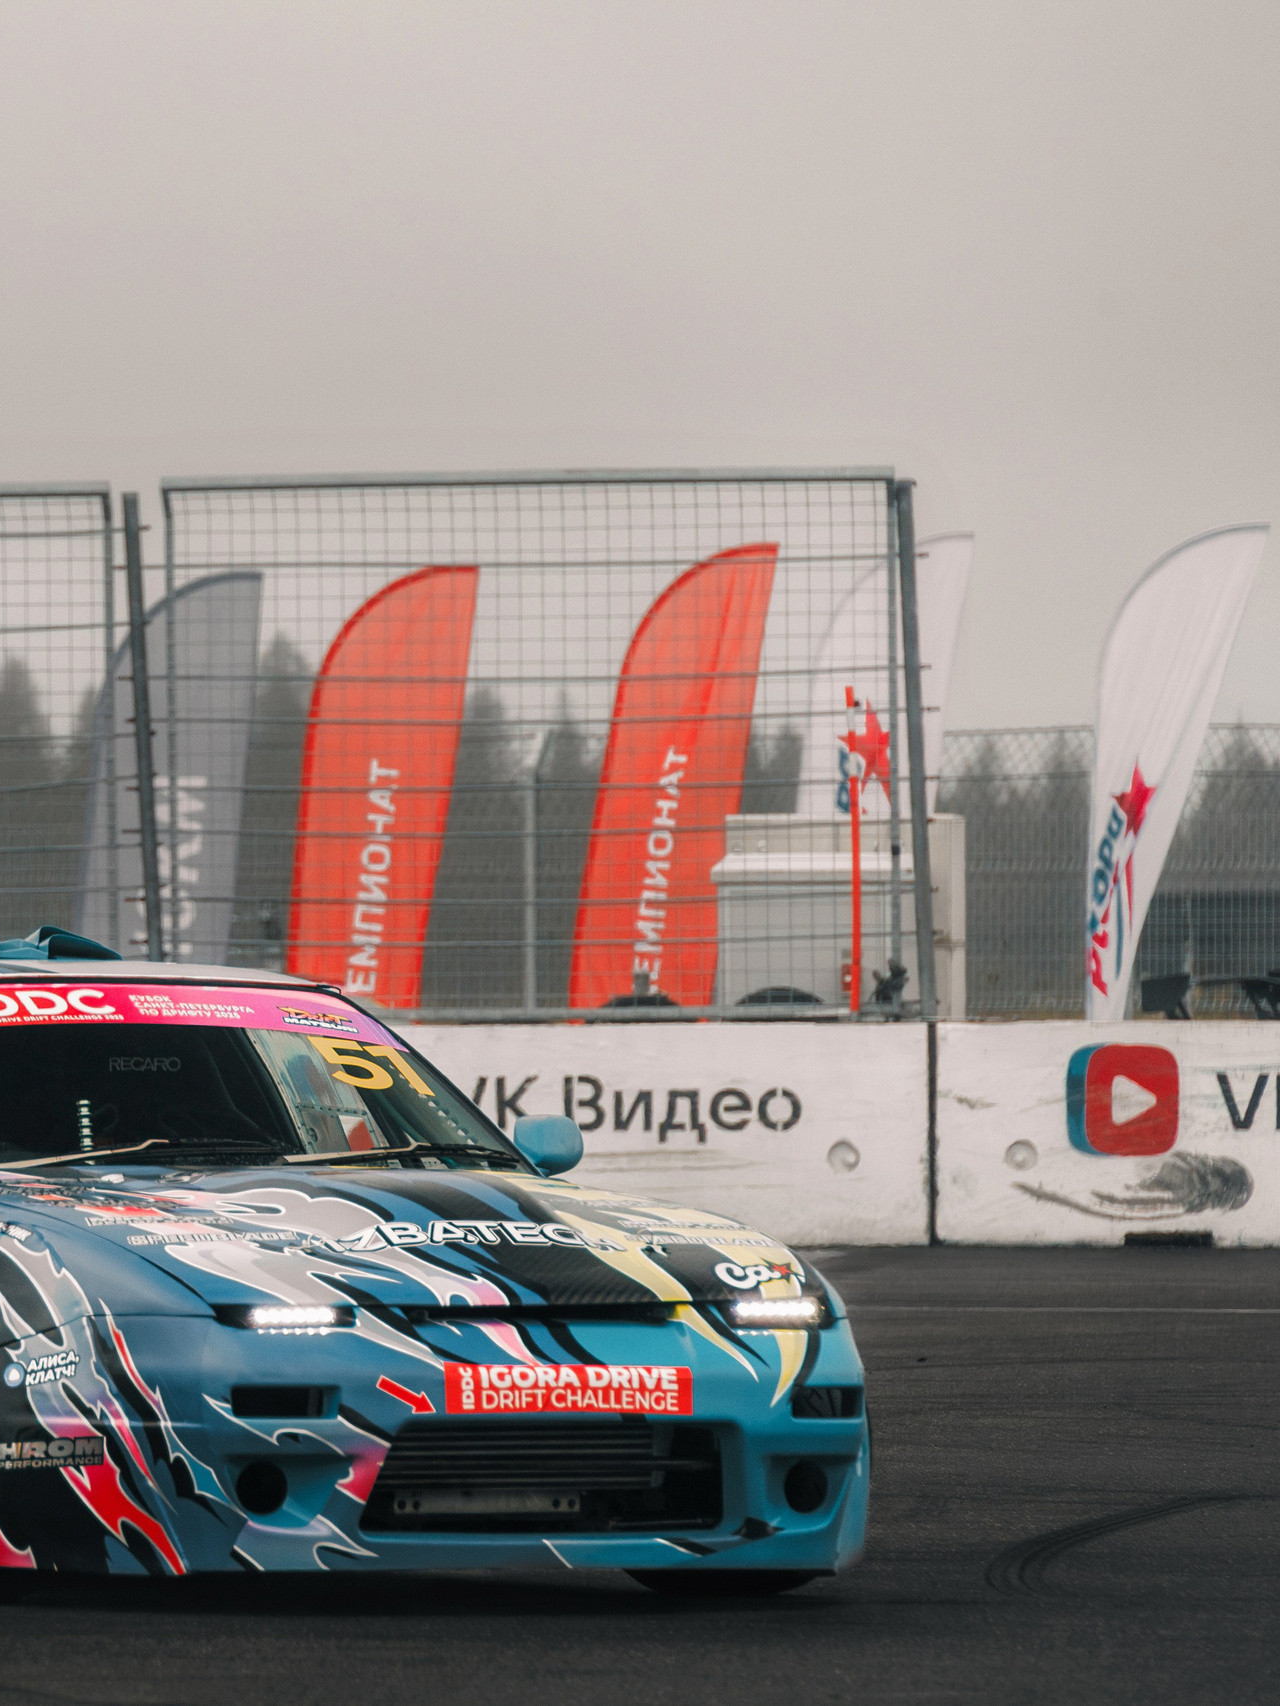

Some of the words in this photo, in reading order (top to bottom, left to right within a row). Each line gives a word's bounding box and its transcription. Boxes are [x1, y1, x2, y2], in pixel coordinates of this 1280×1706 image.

[128, 994, 172, 1003] КУБОК
[134, 1002, 255, 1014] САНКТ-ПЕТЕРБУРГА
[23, 1015, 49, 1023] DRIFT
[51, 1014, 103, 1022] CHALLENGE
[139, 1008, 160, 1017] ПО
[162, 1008, 214, 1018] ДРИФТУ
[215, 1011, 241, 1020] 2025
[283, 1017, 359, 1034] MATSURI
[109, 1056, 181, 1072] RECARO
[307, 1035, 436, 1097] 51
[564, 1074, 802, 1144] Видео
[26, 1351, 80, 1373] АЛИСА,
[25, 1364, 77, 1386] КЛАТЧ!
[479, 1366, 581, 1389] IGORA
[586, 1366, 679, 1390] DRIVE
[459, 1366, 476, 1410] IDDC
[482, 1389, 546, 1410] DRIFT
[551, 1390, 679, 1412] CHALLENGE
